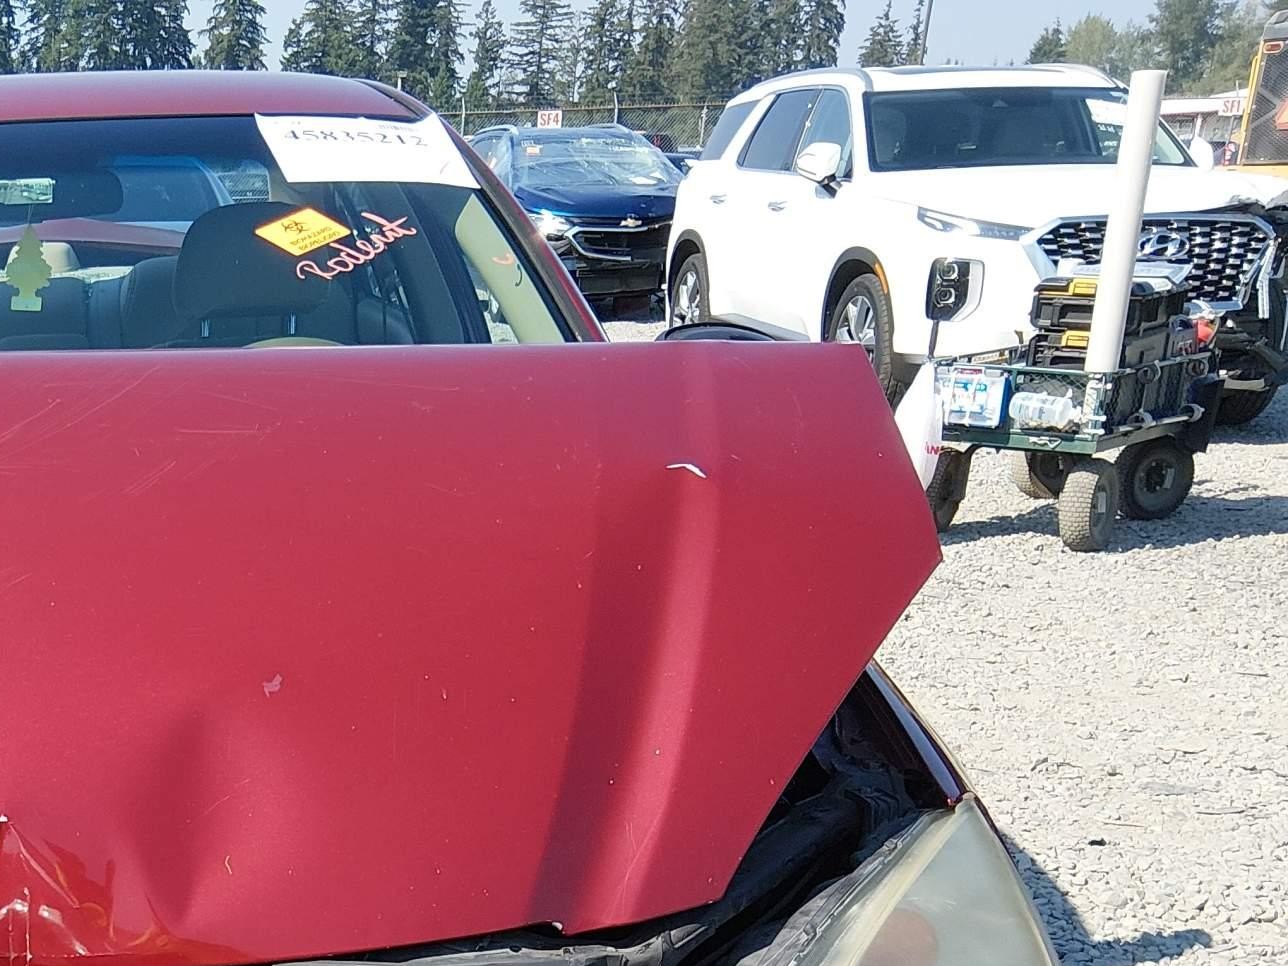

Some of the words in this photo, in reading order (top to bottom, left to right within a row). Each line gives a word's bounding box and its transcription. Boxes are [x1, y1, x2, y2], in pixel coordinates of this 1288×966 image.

[539, 112, 560, 127] SF4
[284, 129, 428, 147] 45835212
[296, 212, 417, 280] Rodent
